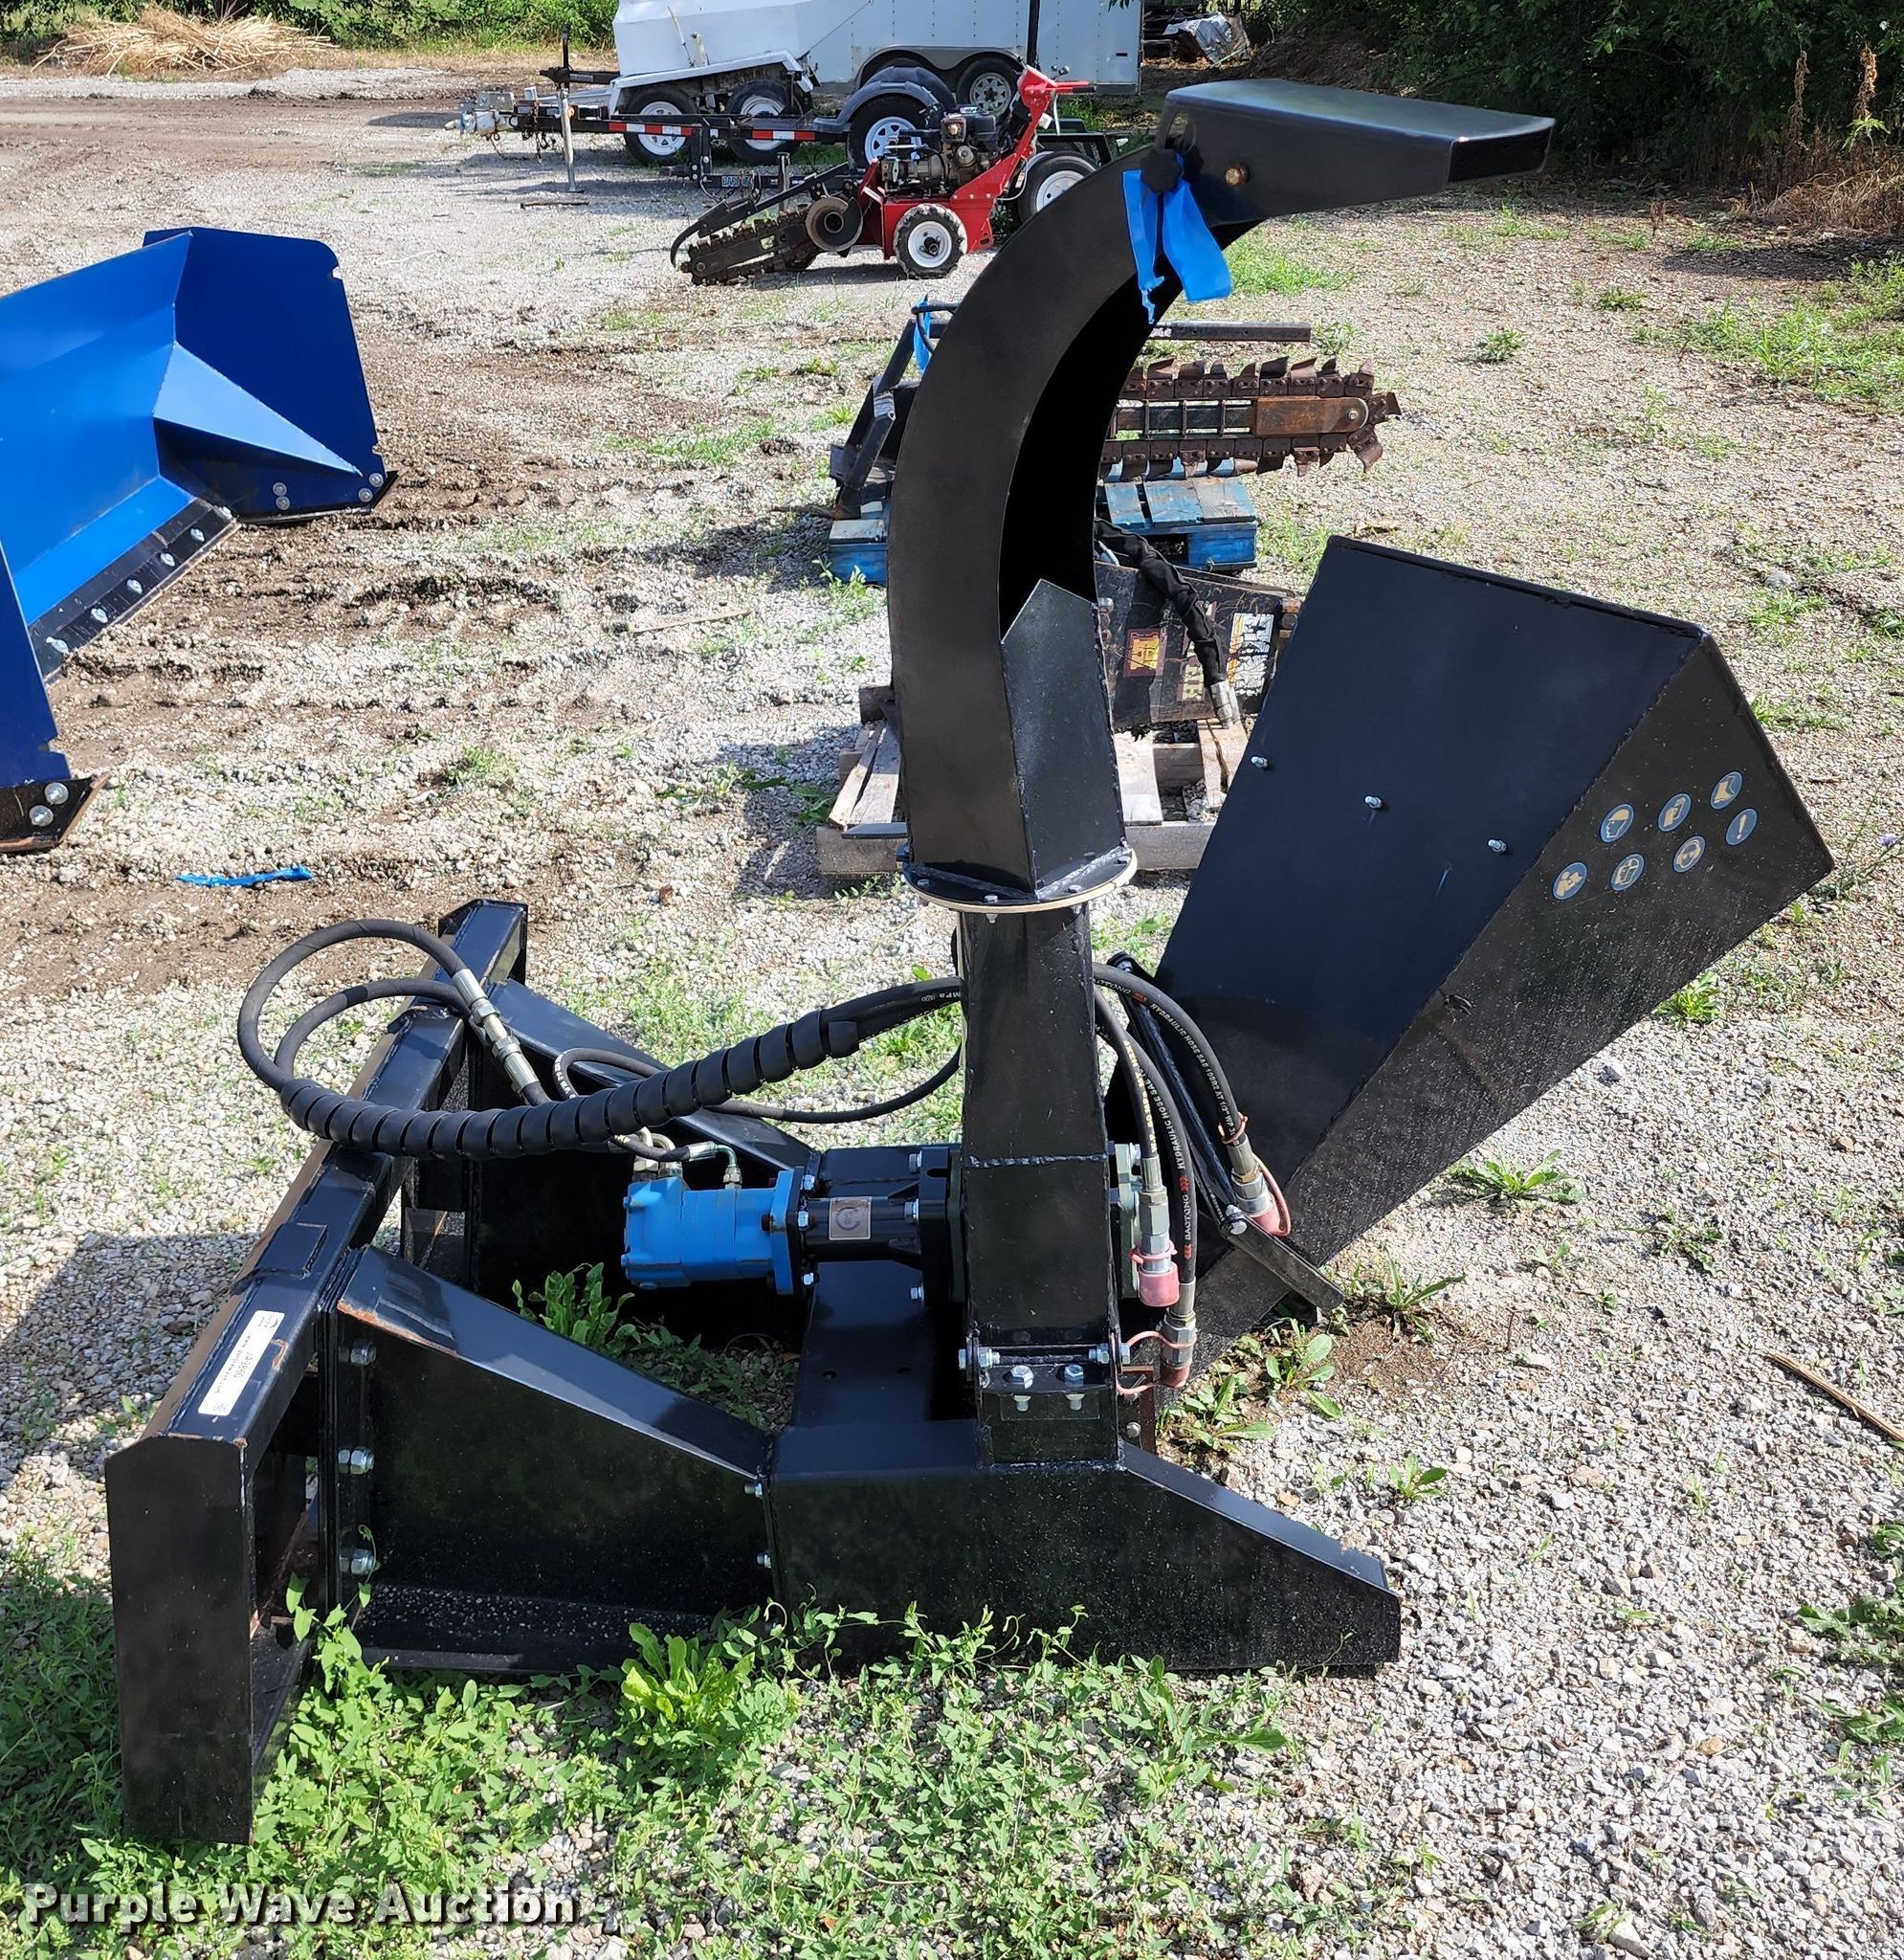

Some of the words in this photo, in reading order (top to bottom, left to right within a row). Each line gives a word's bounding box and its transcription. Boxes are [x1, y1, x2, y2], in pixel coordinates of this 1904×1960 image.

[1149, 1002, 1187, 1036] HYDRAULIC
[1184, 1035, 1201, 1054] HOSE
[1196, 1053, 1209, 1068] SAE
[1205, 1069, 1220, 1090] 100R2
[1214, 1091, 1225, 1102] AT
[1225, 1116, 1233, 1126] WP
[1153, 1096, 1169, 1119] HOSE
[1164, 1120, 1184, 1169] HYDRAULIC
